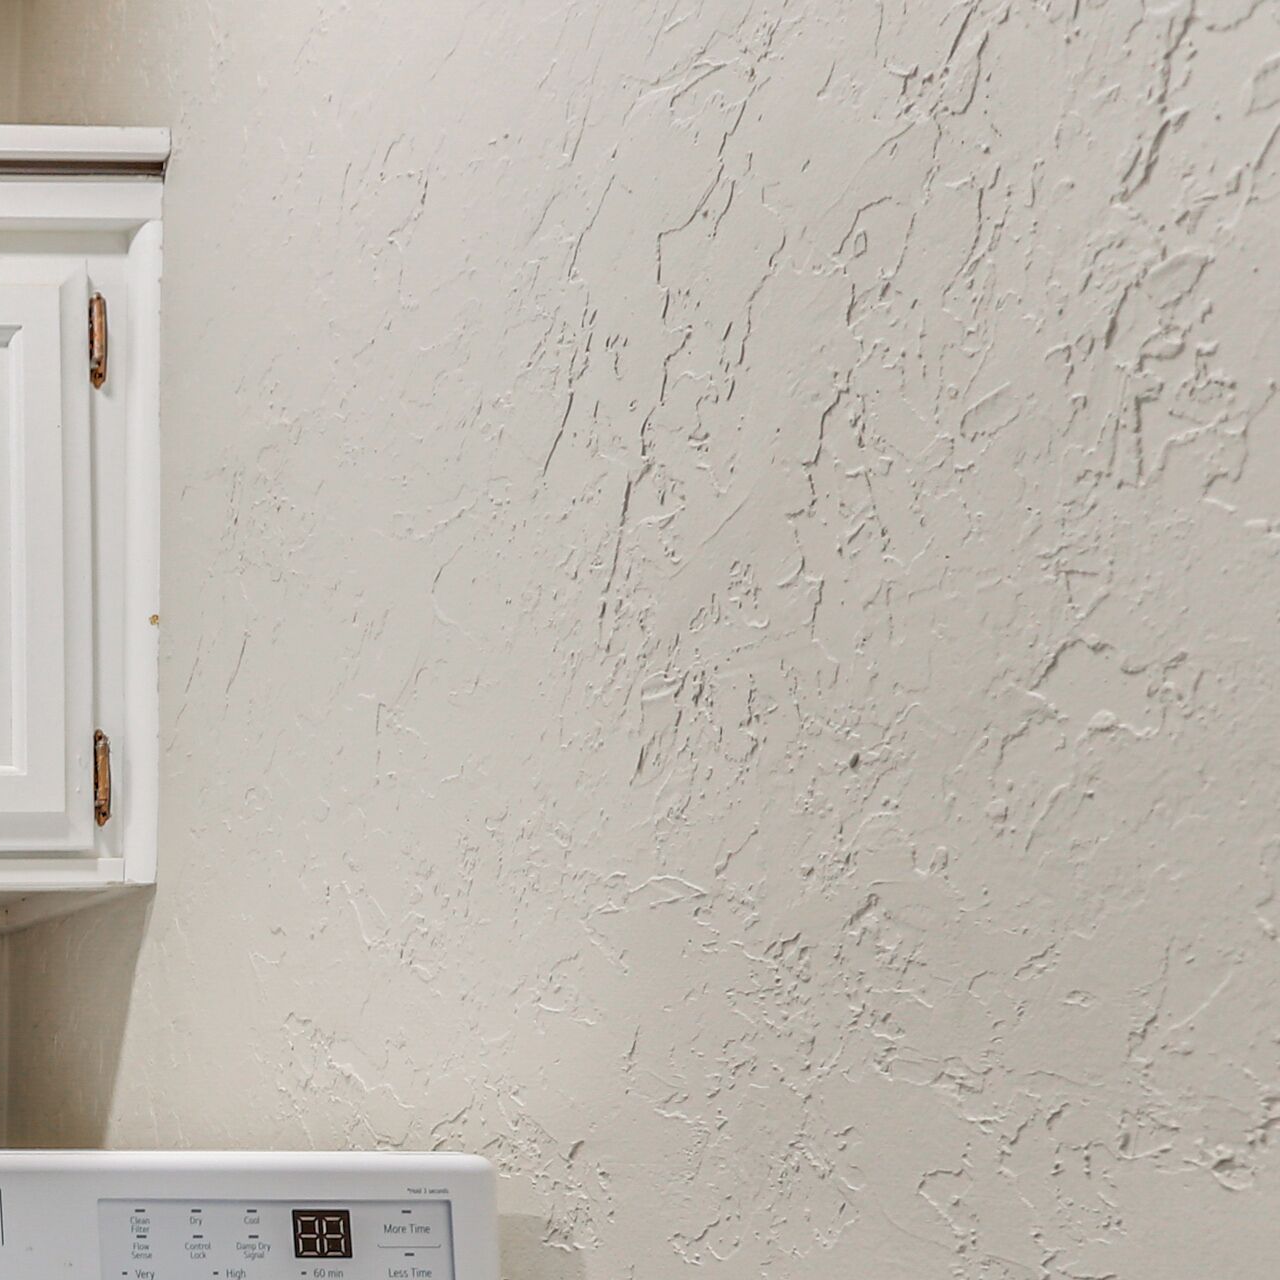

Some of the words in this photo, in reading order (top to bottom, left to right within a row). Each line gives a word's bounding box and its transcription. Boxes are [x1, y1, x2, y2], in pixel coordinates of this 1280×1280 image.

[190, 1217, 202, 1226] Dry
[384, 1224, 407, 1233] More
[410, 1224, 431, 1233] Time
[133, 1242, 149, 1250] Flow
[185, 1242, 211, 1250] Control
[236, 1243, 256, 1251] Damp
[258, 1243, 271, 1251] Dry
[244, 1252, 264, 1260] Signal
[135, 1270, 155, 1280] Very
[227, 1269, 246, 1280] High
[314, 1269, 326, 1278] 60
[328, 1269, 343, 1278] min
[388, 1268, 408, 1278] Less
[412, 1268, 432, 1278] Time
